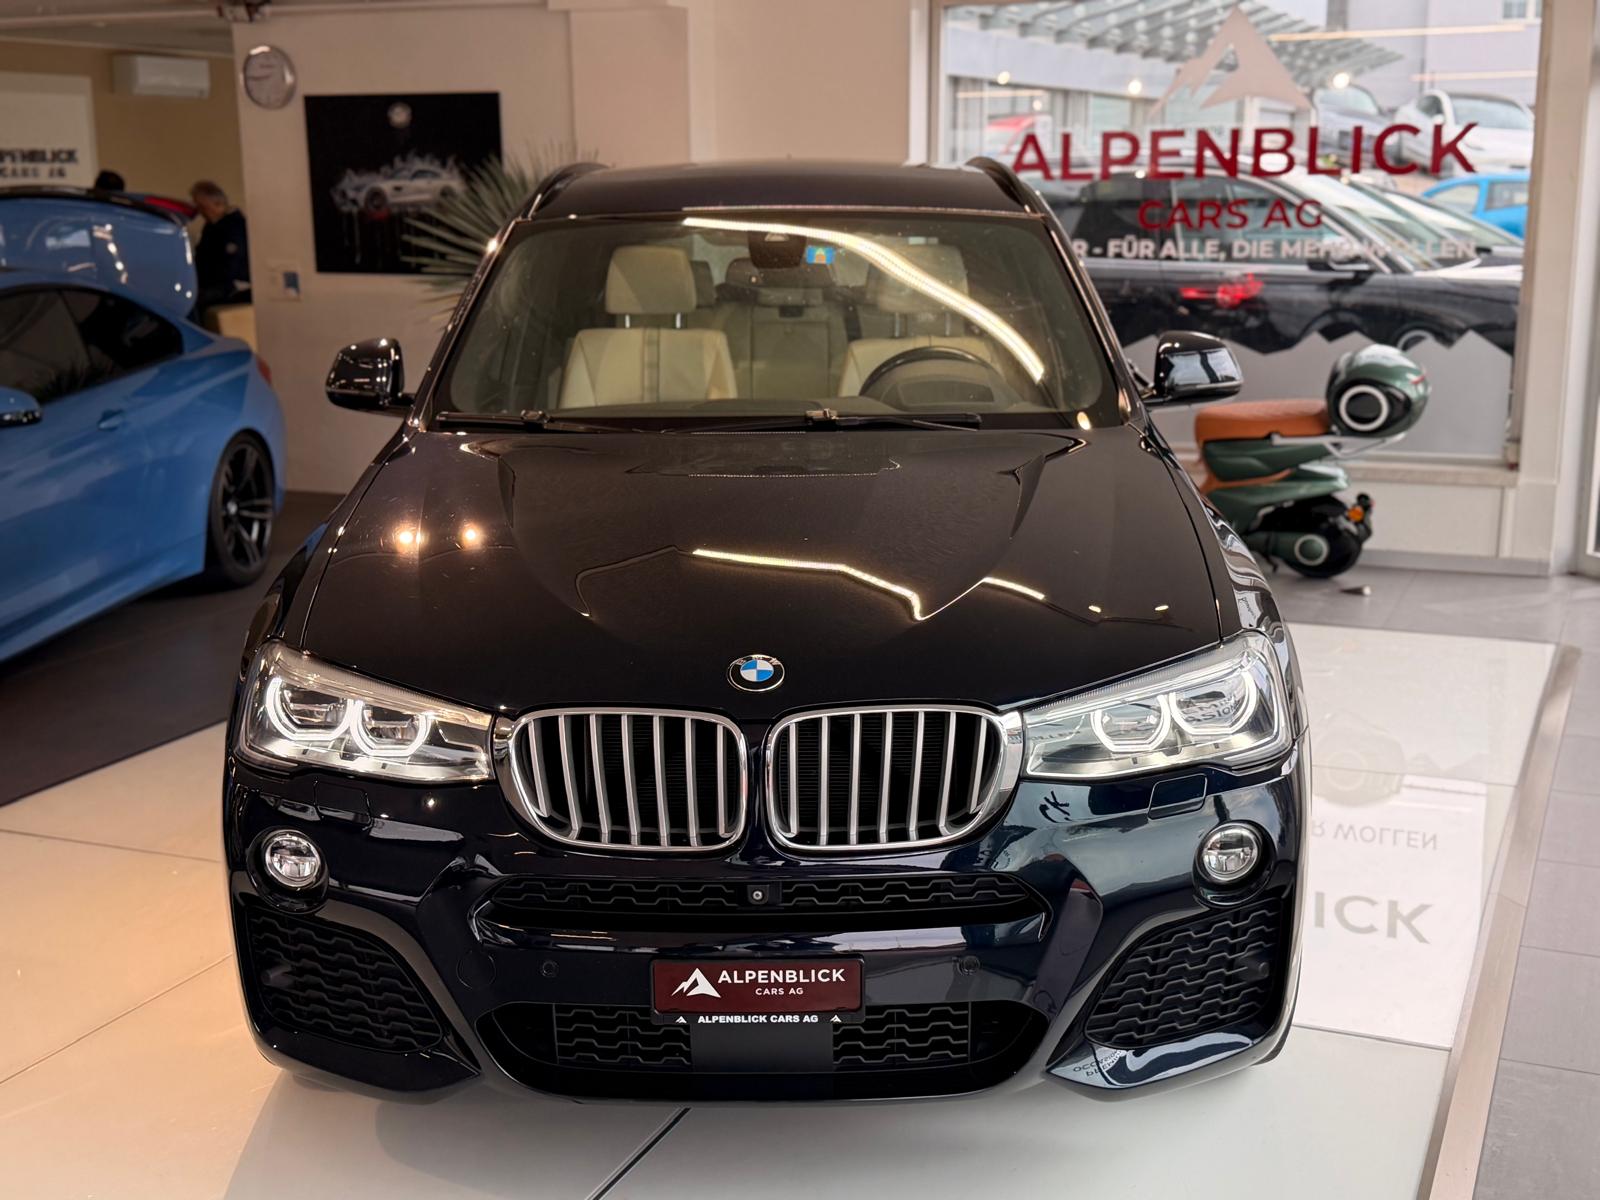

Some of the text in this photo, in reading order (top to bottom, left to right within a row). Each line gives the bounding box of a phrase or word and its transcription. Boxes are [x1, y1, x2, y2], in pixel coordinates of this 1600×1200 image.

[1012, 121, 1479, 182] ALPENBLICK
[1137, 199, 1324, 231] CARS AG
[1106, 233, 1155, 259] FÜR
[1159, 239, 1227, 262] ALLE,
[1232, 239, 1274, 259] DIE
[717, 968, 846, 984] ALPENBLICK
[755, 987, 804, 996] CARS AG
[697, 1014, 819, 1024] ALPENBLICK CARS AG
